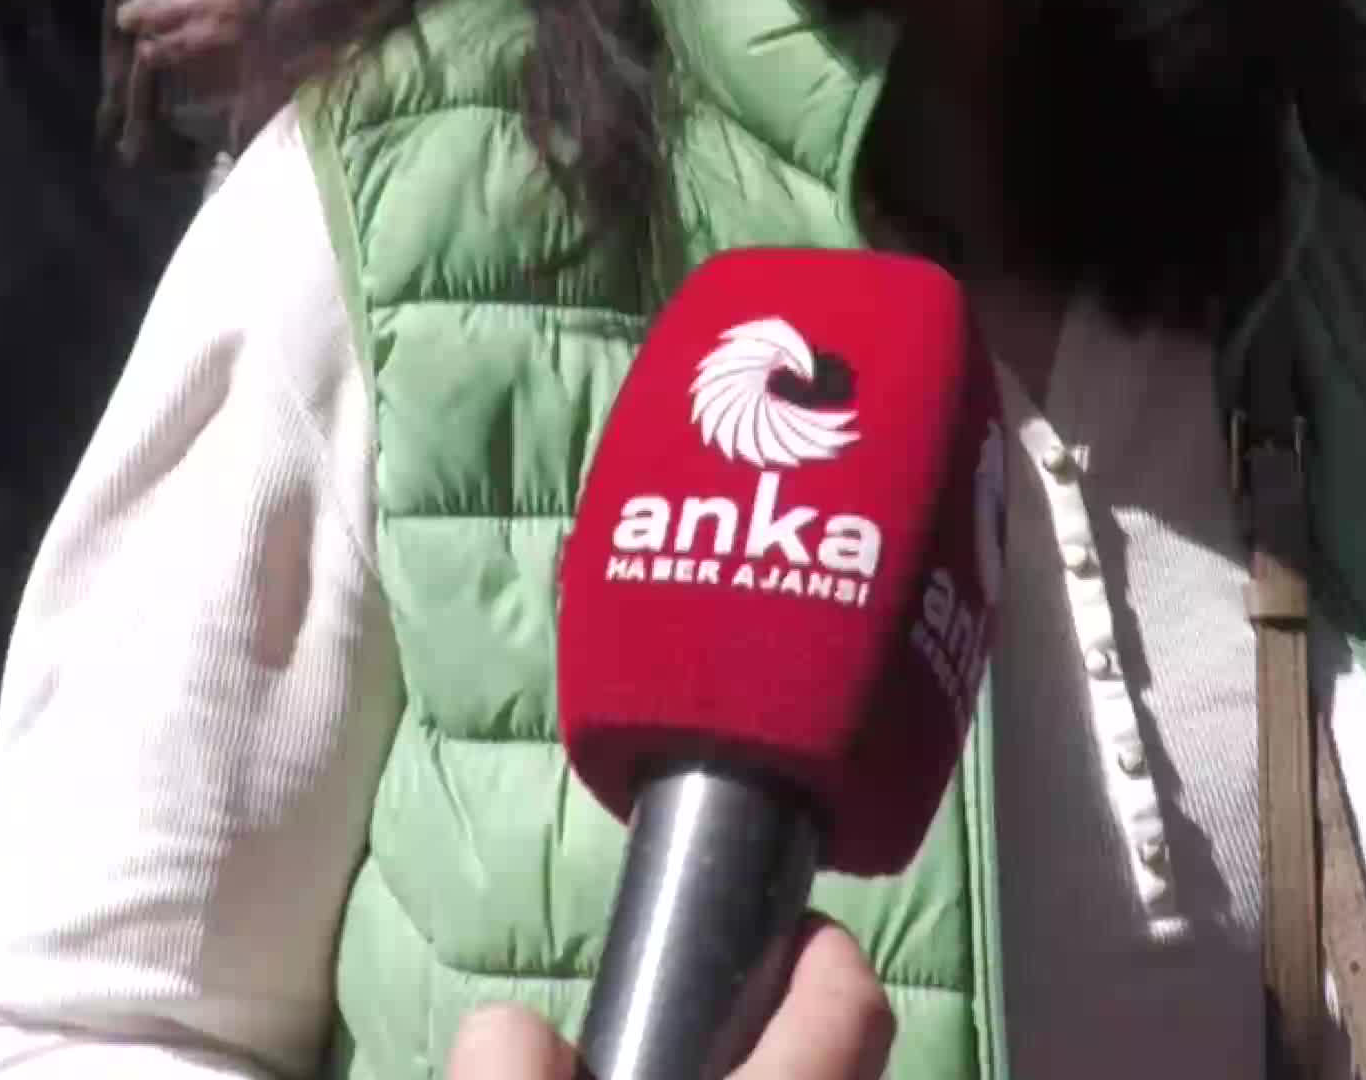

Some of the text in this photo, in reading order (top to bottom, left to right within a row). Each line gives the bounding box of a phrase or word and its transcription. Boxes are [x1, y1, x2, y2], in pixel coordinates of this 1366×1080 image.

[612, 471, 882, 578] anka
[605, 555, 871, 608] HABER AJANSI
